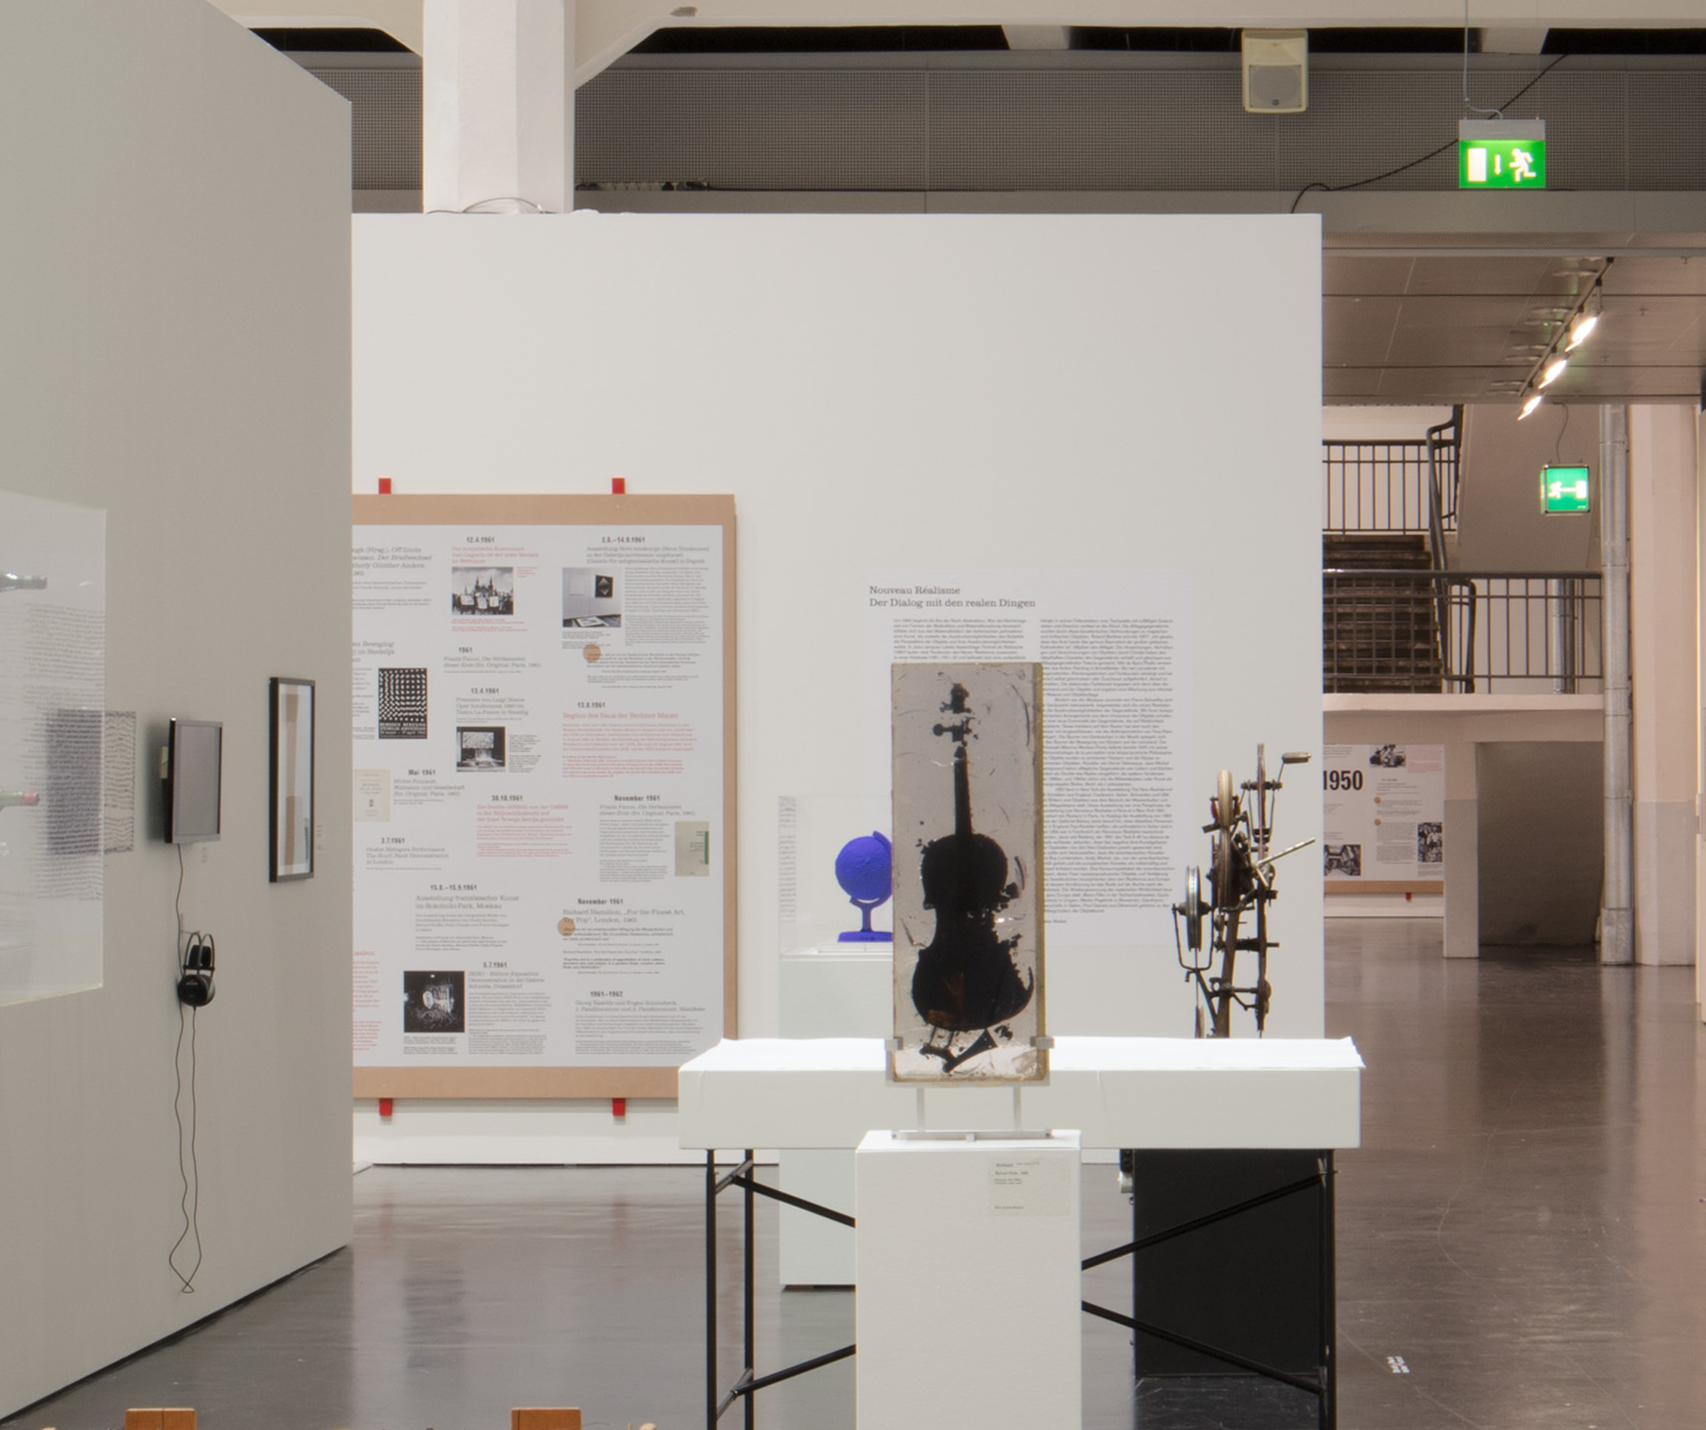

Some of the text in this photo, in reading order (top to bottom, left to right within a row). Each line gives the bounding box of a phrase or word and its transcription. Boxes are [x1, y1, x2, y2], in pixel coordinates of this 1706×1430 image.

[869, 584, 961, 595] Nouveau Réalisme
[869, 598, 1036, 609] Der Dialog mit den realen Dingen
[1323, 770, 1364, 790] 1950
